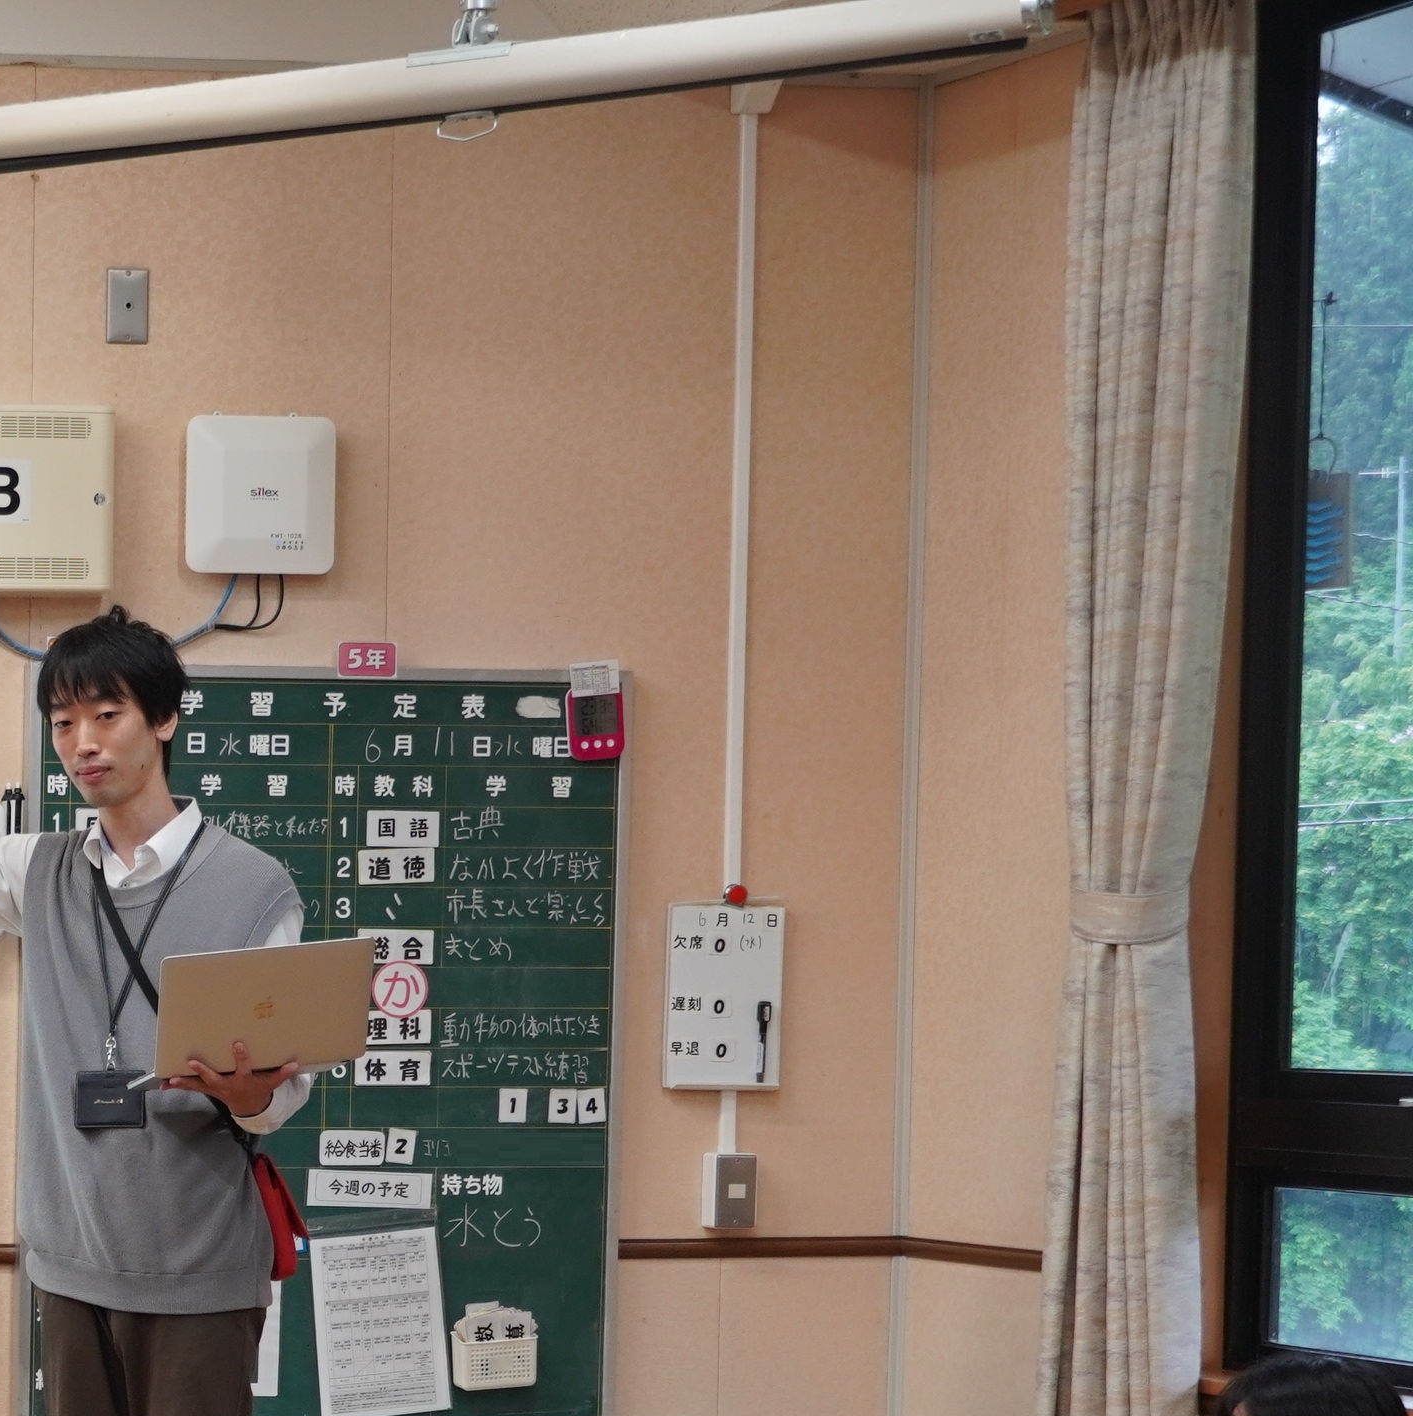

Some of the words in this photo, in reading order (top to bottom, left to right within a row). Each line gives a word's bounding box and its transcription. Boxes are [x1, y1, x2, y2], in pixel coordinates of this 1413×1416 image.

[250, 487, 279, 497] silex
[347, 648, 387, 670] 5年
[47, 774, 68, 796] 時
[201, 774, 288, 797] 学習
[334, 775, 356, 797] 時
[374, 775, 433, 798] 教科
[485, 775, 572, 798] 学習
[339, 816, 348, 838] 1
[378, 818, 429, 838] 国語
[450, 806, 505, 840] 古典
[336, 856, 351, 878] 2
[368, 856, 426, 880] 道徳
[335, 897, 351, 918] 3
[445, 932, 512, 961] まとめ
[673, 934, 703, 950] 欠席
[714, 938, 726, 953] 0
[383, 971, 420, 1008] か
[671, 996, 702, 1012] 遅刻
[713, 999, 724, 1015] 0
[367, 1017, 421, 1040] 理科
[669, 1040, 700, 1057] 早退
[715, 1043, 727, 1058] 0
[365, 1058, 421, 1082] 体育
[557, 1097, 569, 1115] 3
[585, 1097, 598, 1114] 4
[324, 1138, 383, 1159] 給食当番
[394, 1138, 408, 1155] 2
[328, 1178, 410, 1199] 今週の予定
[441, 1174, 503, 1196] 持ち物
[443, 1202, 541, 1247] 水とう
